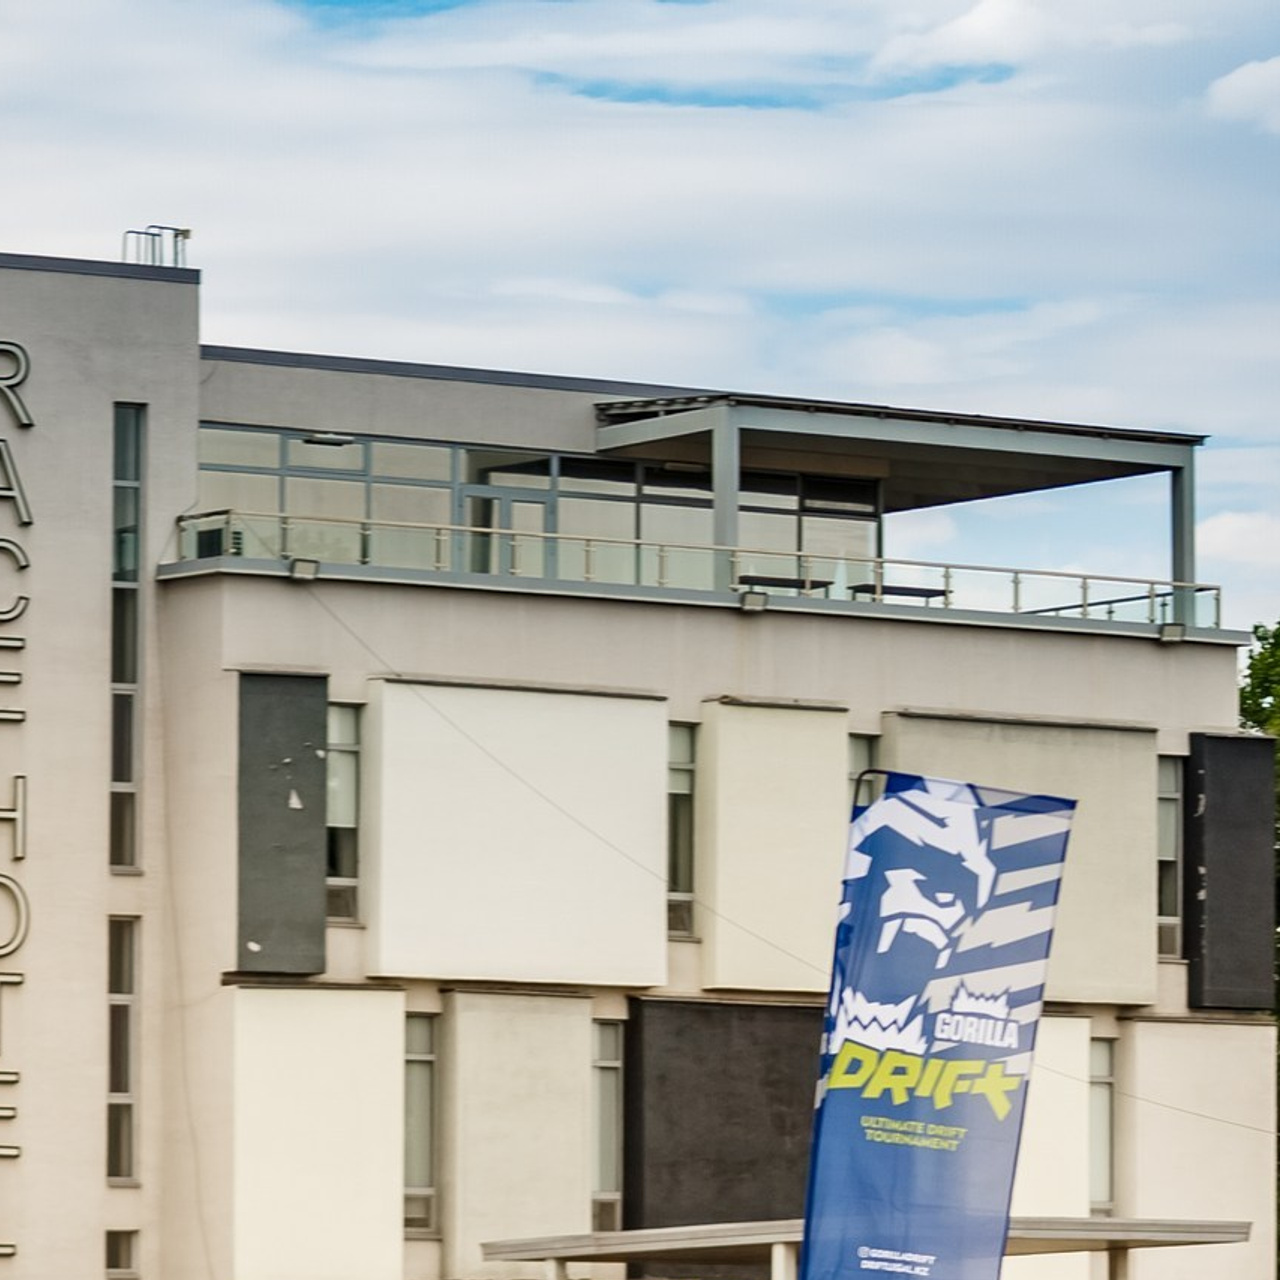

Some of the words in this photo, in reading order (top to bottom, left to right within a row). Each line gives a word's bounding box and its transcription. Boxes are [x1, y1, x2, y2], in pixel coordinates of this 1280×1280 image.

[934, 1012, 1019, 1049] GORILLA
[827, 1040, 1022, 1122] DRIFT
[860, 1115, 926, 1134] ULTIMATE
[926, 1123, 969, 1140] DRIFT
[864, 1128, 961, 1152] TOURNAMENT
